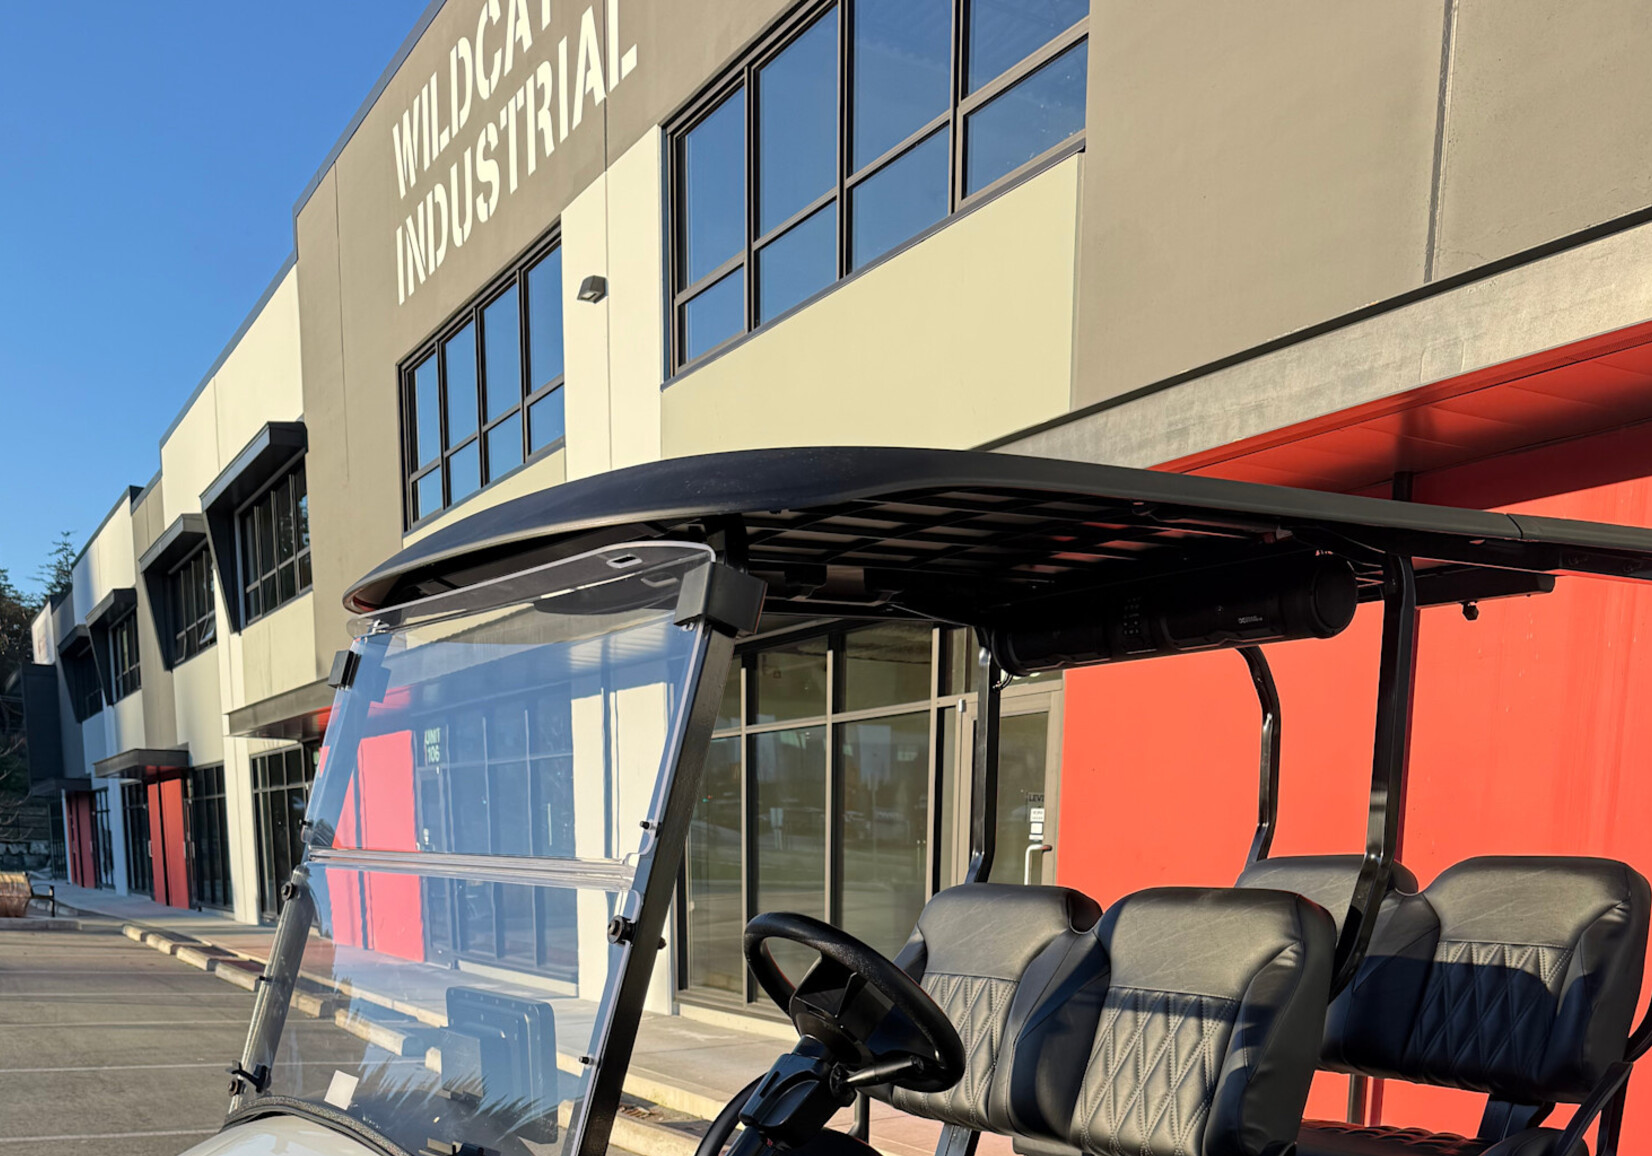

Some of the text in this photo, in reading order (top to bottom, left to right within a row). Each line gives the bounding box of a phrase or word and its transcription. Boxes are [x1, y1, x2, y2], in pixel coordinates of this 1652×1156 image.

[396, 0, 637, 306] INDUSTRIAL
[424, 727, 440, 745] UNIT
[427, 744, 440, 763] 106
